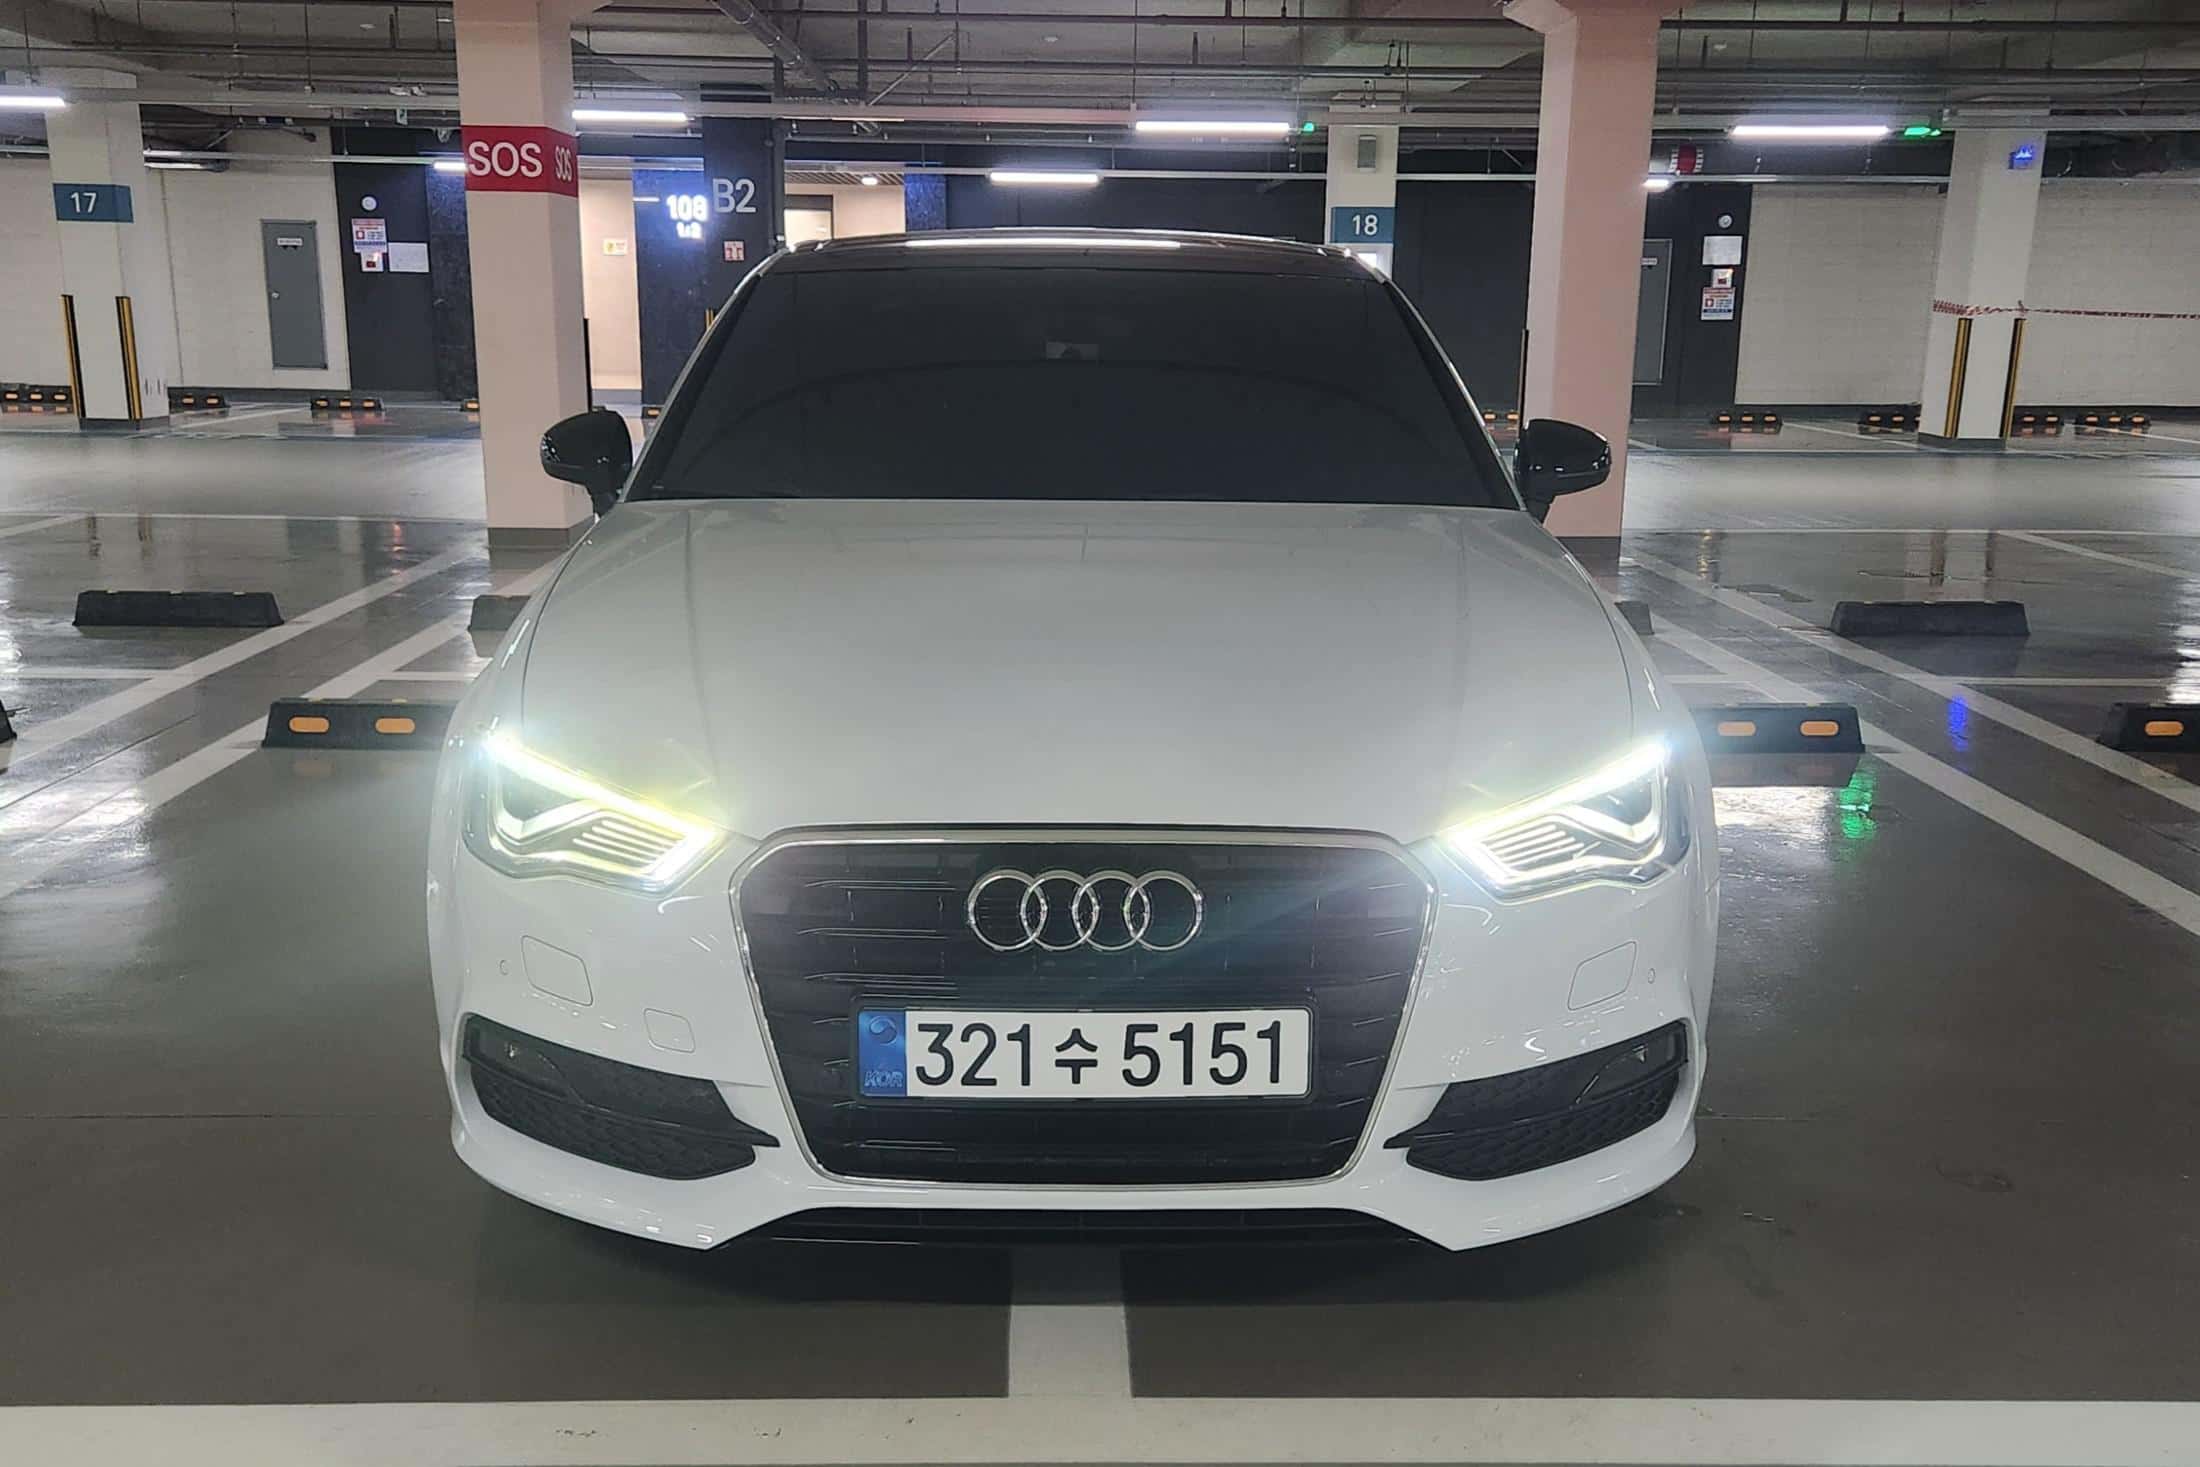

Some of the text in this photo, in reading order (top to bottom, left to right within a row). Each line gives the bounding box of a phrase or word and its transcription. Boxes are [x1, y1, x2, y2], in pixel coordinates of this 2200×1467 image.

[468, 141, 543, 178] SOS
[554, 145, 573, 182] SOS
[70, 192, 97, 213] 17
[712, 178, 757, 213] B2
[1352, 214, 1378, 236] 18
[864, 1071, 904, 1088] KOR
